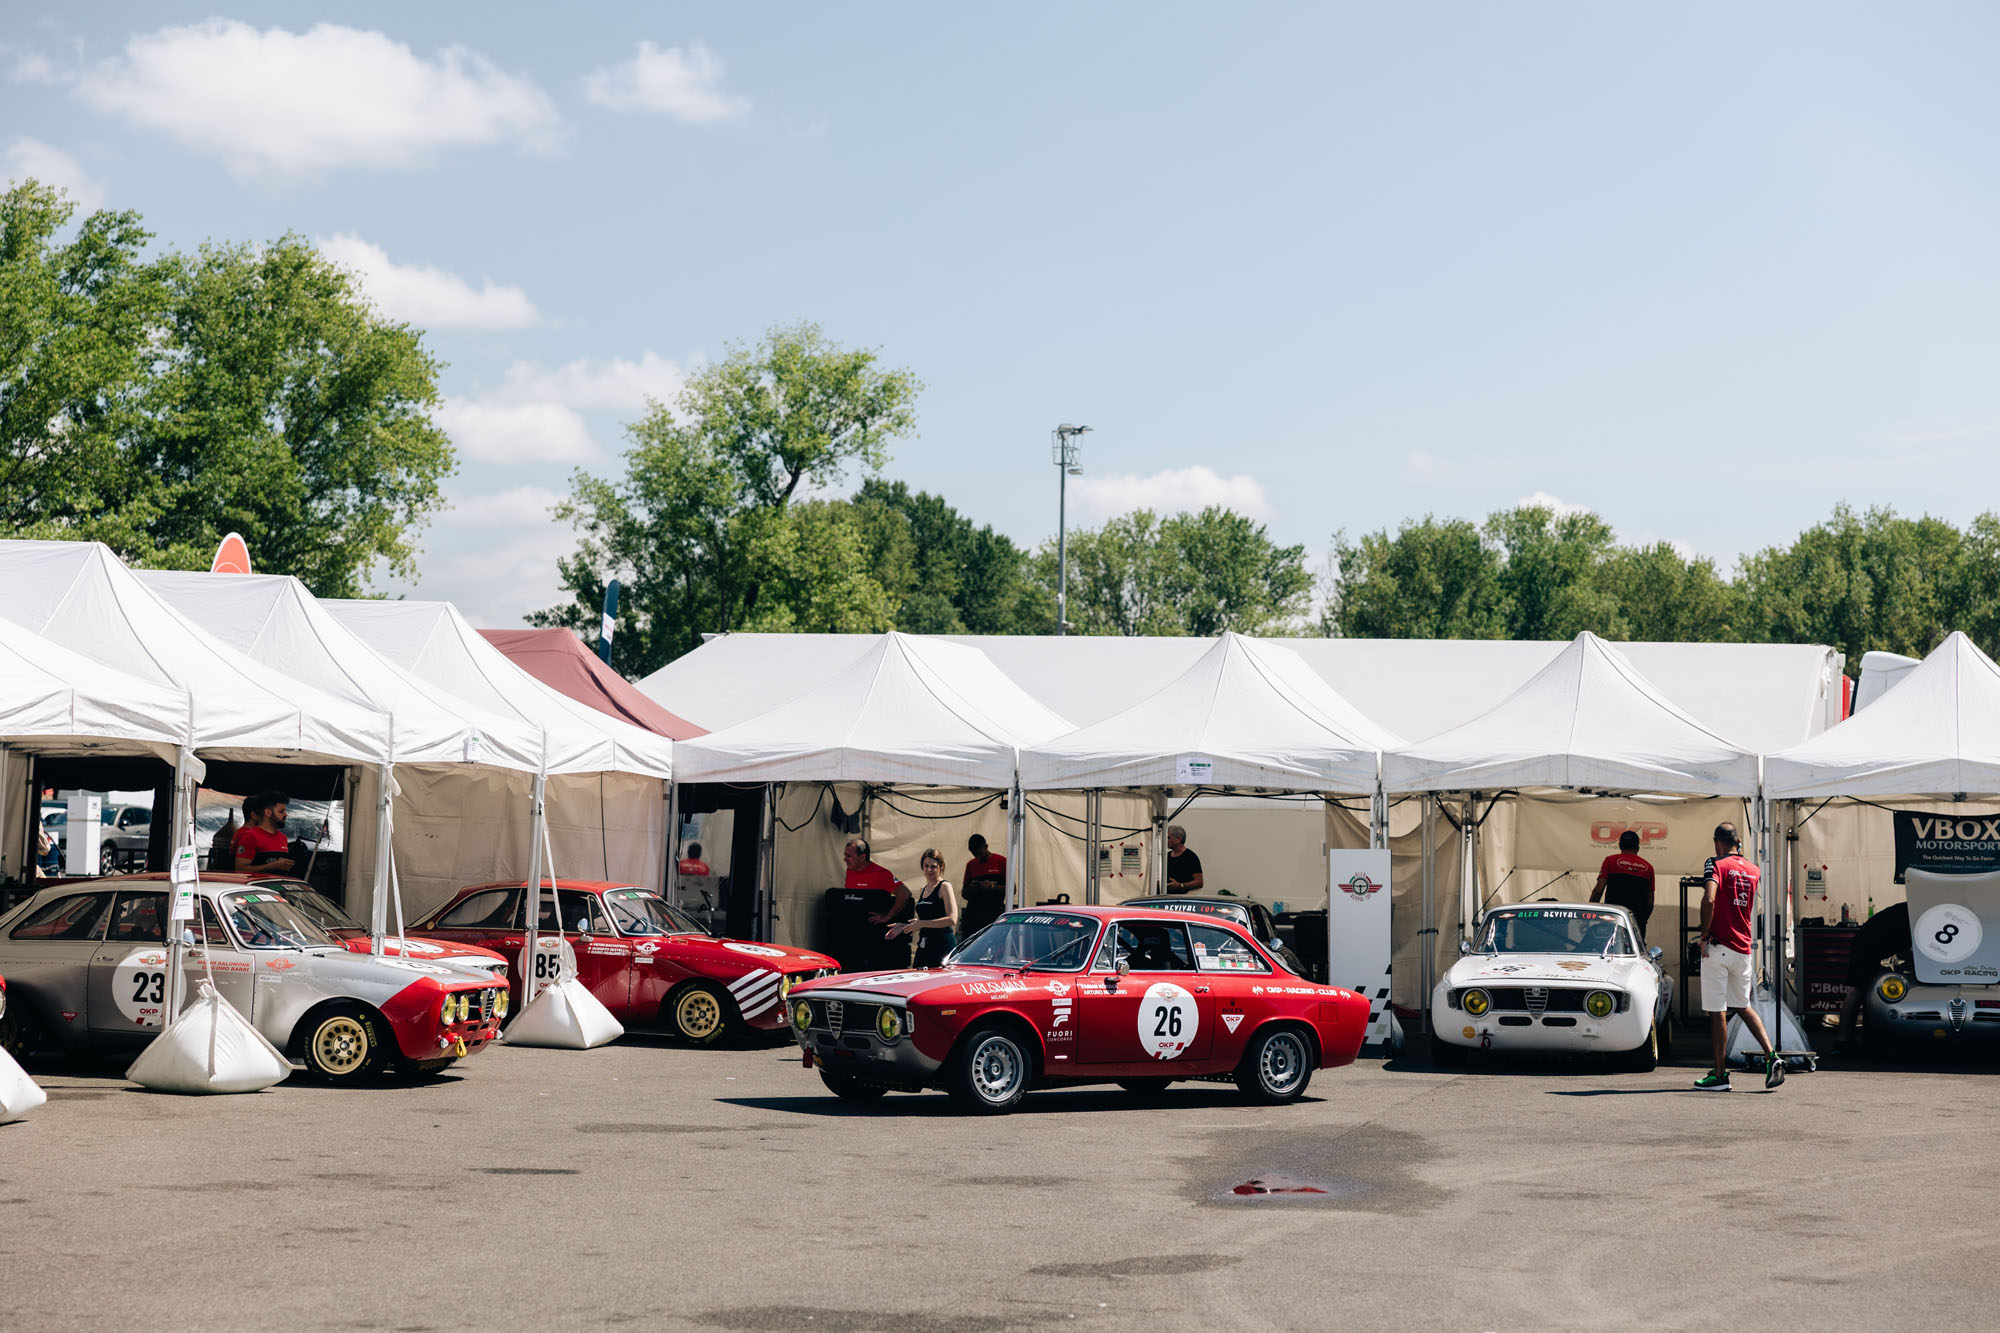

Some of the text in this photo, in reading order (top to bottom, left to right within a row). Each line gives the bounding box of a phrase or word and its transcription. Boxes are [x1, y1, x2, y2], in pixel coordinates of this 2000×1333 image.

[1911, 818, 2000, 840] VBOX
[1164, 904, 1196, 912] REVIVAL
[1543, 911, 1578, 919] REVIVAL
[1935, 924, 1959, 944] 8
[536, 953, 560, 979] 85
[1964, 969, 1998, 977] RACING
[133, 972, 164, 1003] 23
[1154, 1006, 1182, 1037] 26
